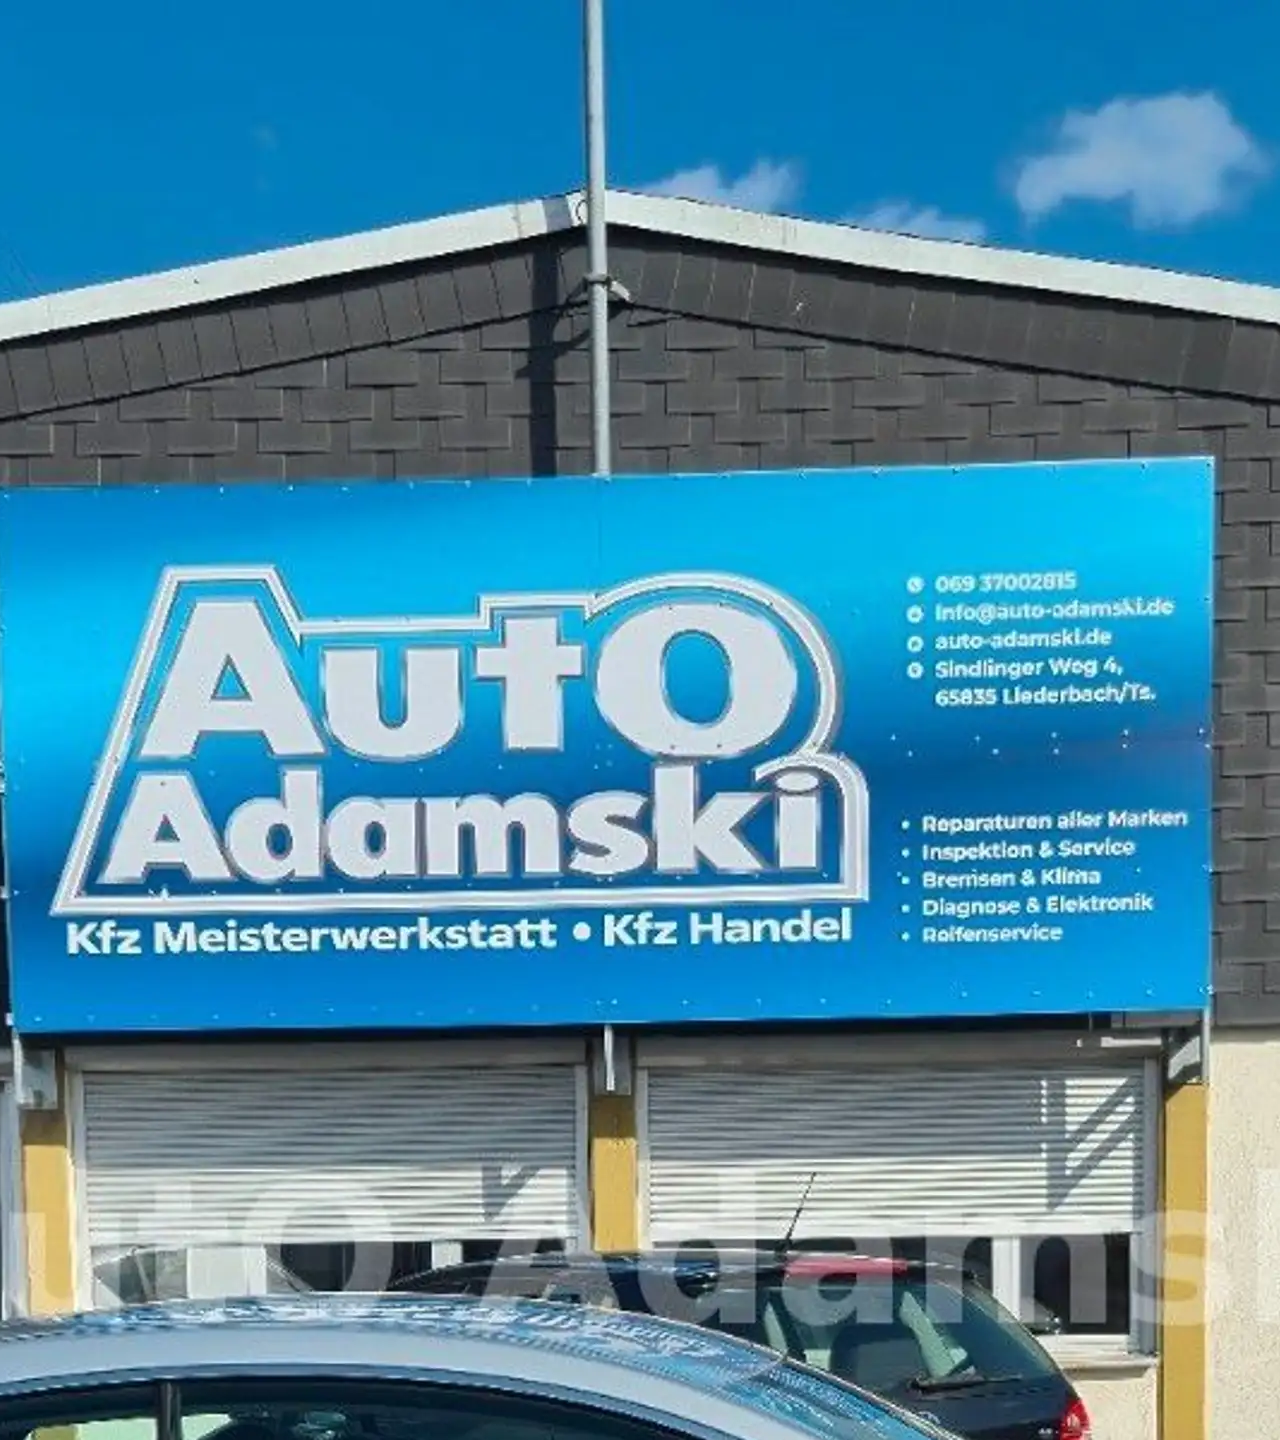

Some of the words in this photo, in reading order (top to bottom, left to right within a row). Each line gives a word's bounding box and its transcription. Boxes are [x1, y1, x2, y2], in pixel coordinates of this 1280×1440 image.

[935, 575, 975, 593] 069
[979, 570, 1077, 592] 37002815
[935, 597, 1175, 625] info@auto-adamski.de
[935, 626, 1112, 651] auto-adamski.de
[935, 657, 1044, 681] Sindlinger
[1047, 657, 1099, 679] Weg
[1103, 655, 1124, 676] 4,
[935, 687, 998, 707] 65835
[1002, 681, 1157, 705] Liederbach/Ts.
[96, 760, 822, 884] Adamski
[922, 813, 1053, 836] Reparaturen
[1057, 810, 1103, 830] aller
[1107, 808, 1189, 828] Marken
[922, 841, 1034, 863] Inspektion
[1038, 840, 1055, 859] &
[1058, 837, 1137, 858] Service
[922, 869, 1017, 889] Bremsen
[1020, 868, 1037, 887] &
[1040, 866, 1102, 886] Klima
[922, 897, 1022, 919] Diagnose
[1025, 896, 1041, 914] &
[1045, 892, 1155, 914] Elektronik
[65, 921, 142, 956] Kfz
[153, 917, 558, 955] Meisterwerkstatt
[603, 911, 678, 948] Kfz
[688, 907, 854, 945] Handel
[922, 921, 1064, 943] Reifenservice
